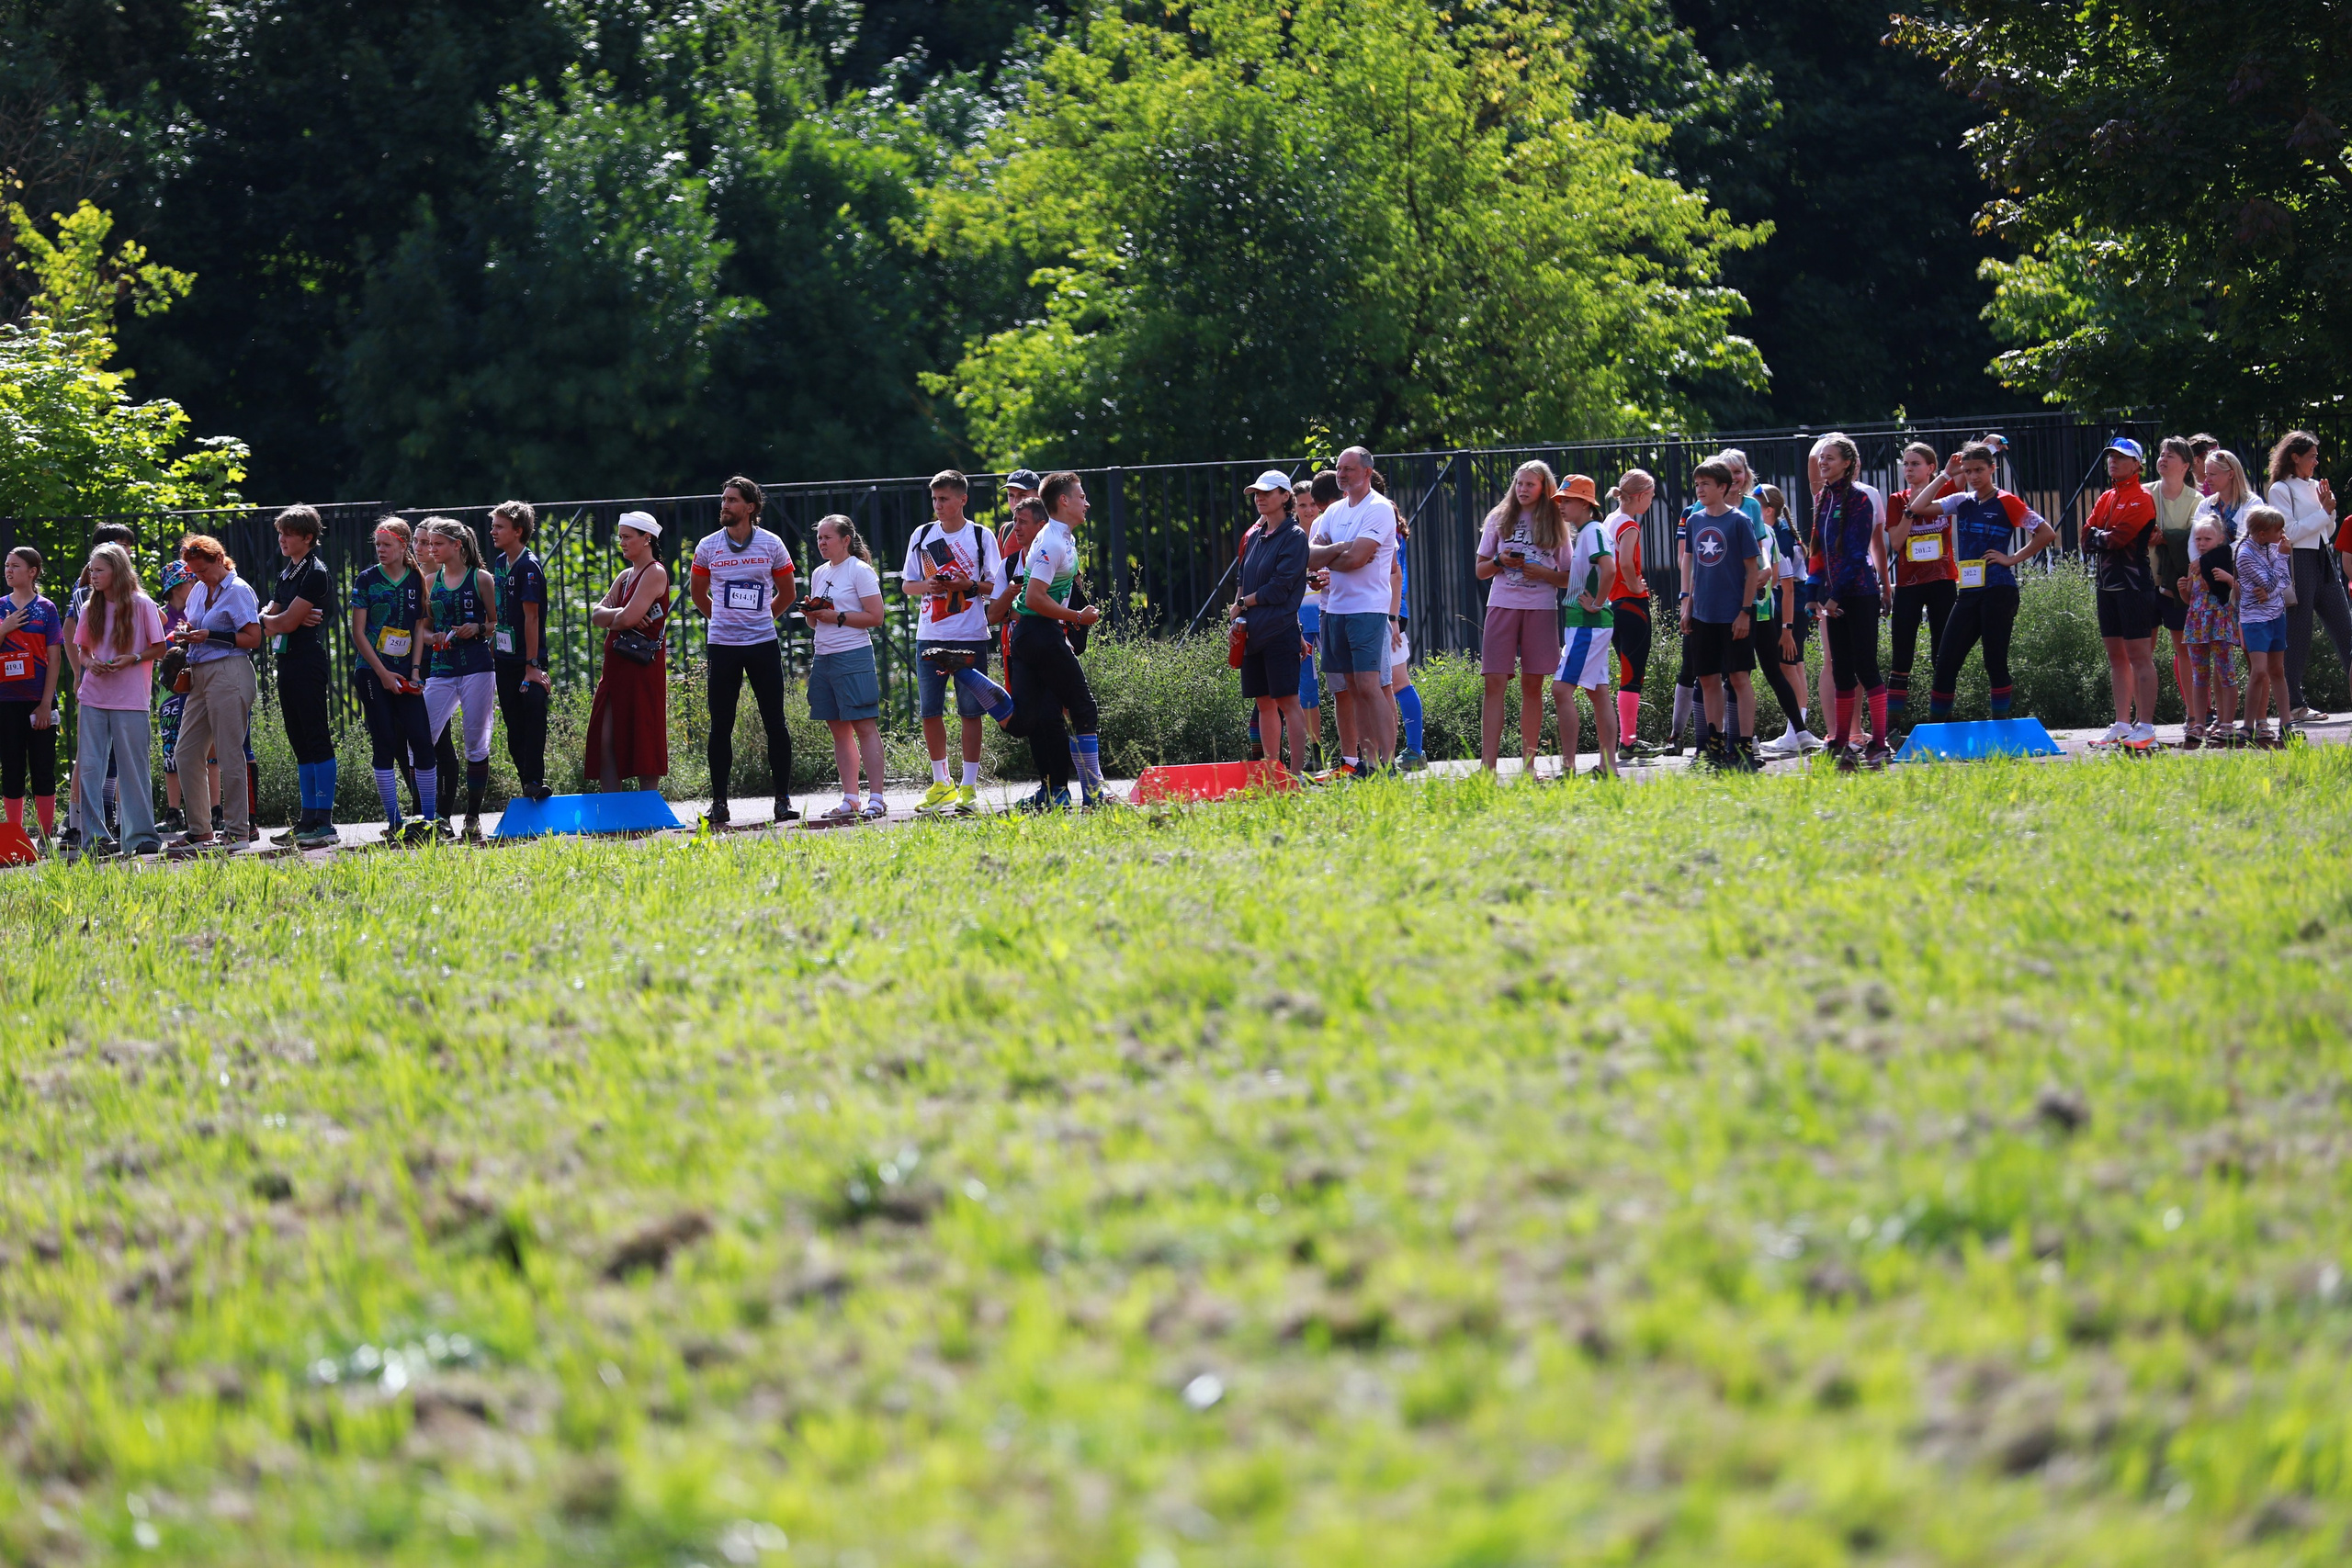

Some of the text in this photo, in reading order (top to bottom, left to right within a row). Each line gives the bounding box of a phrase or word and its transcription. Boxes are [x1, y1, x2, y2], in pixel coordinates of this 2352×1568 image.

[1915, 546, 1931, 555] 201.2
[710, 559, 739, 569] NORD
[390, 638, 407, 648] 251.1
[6, 663, 23, 671] 419.1
